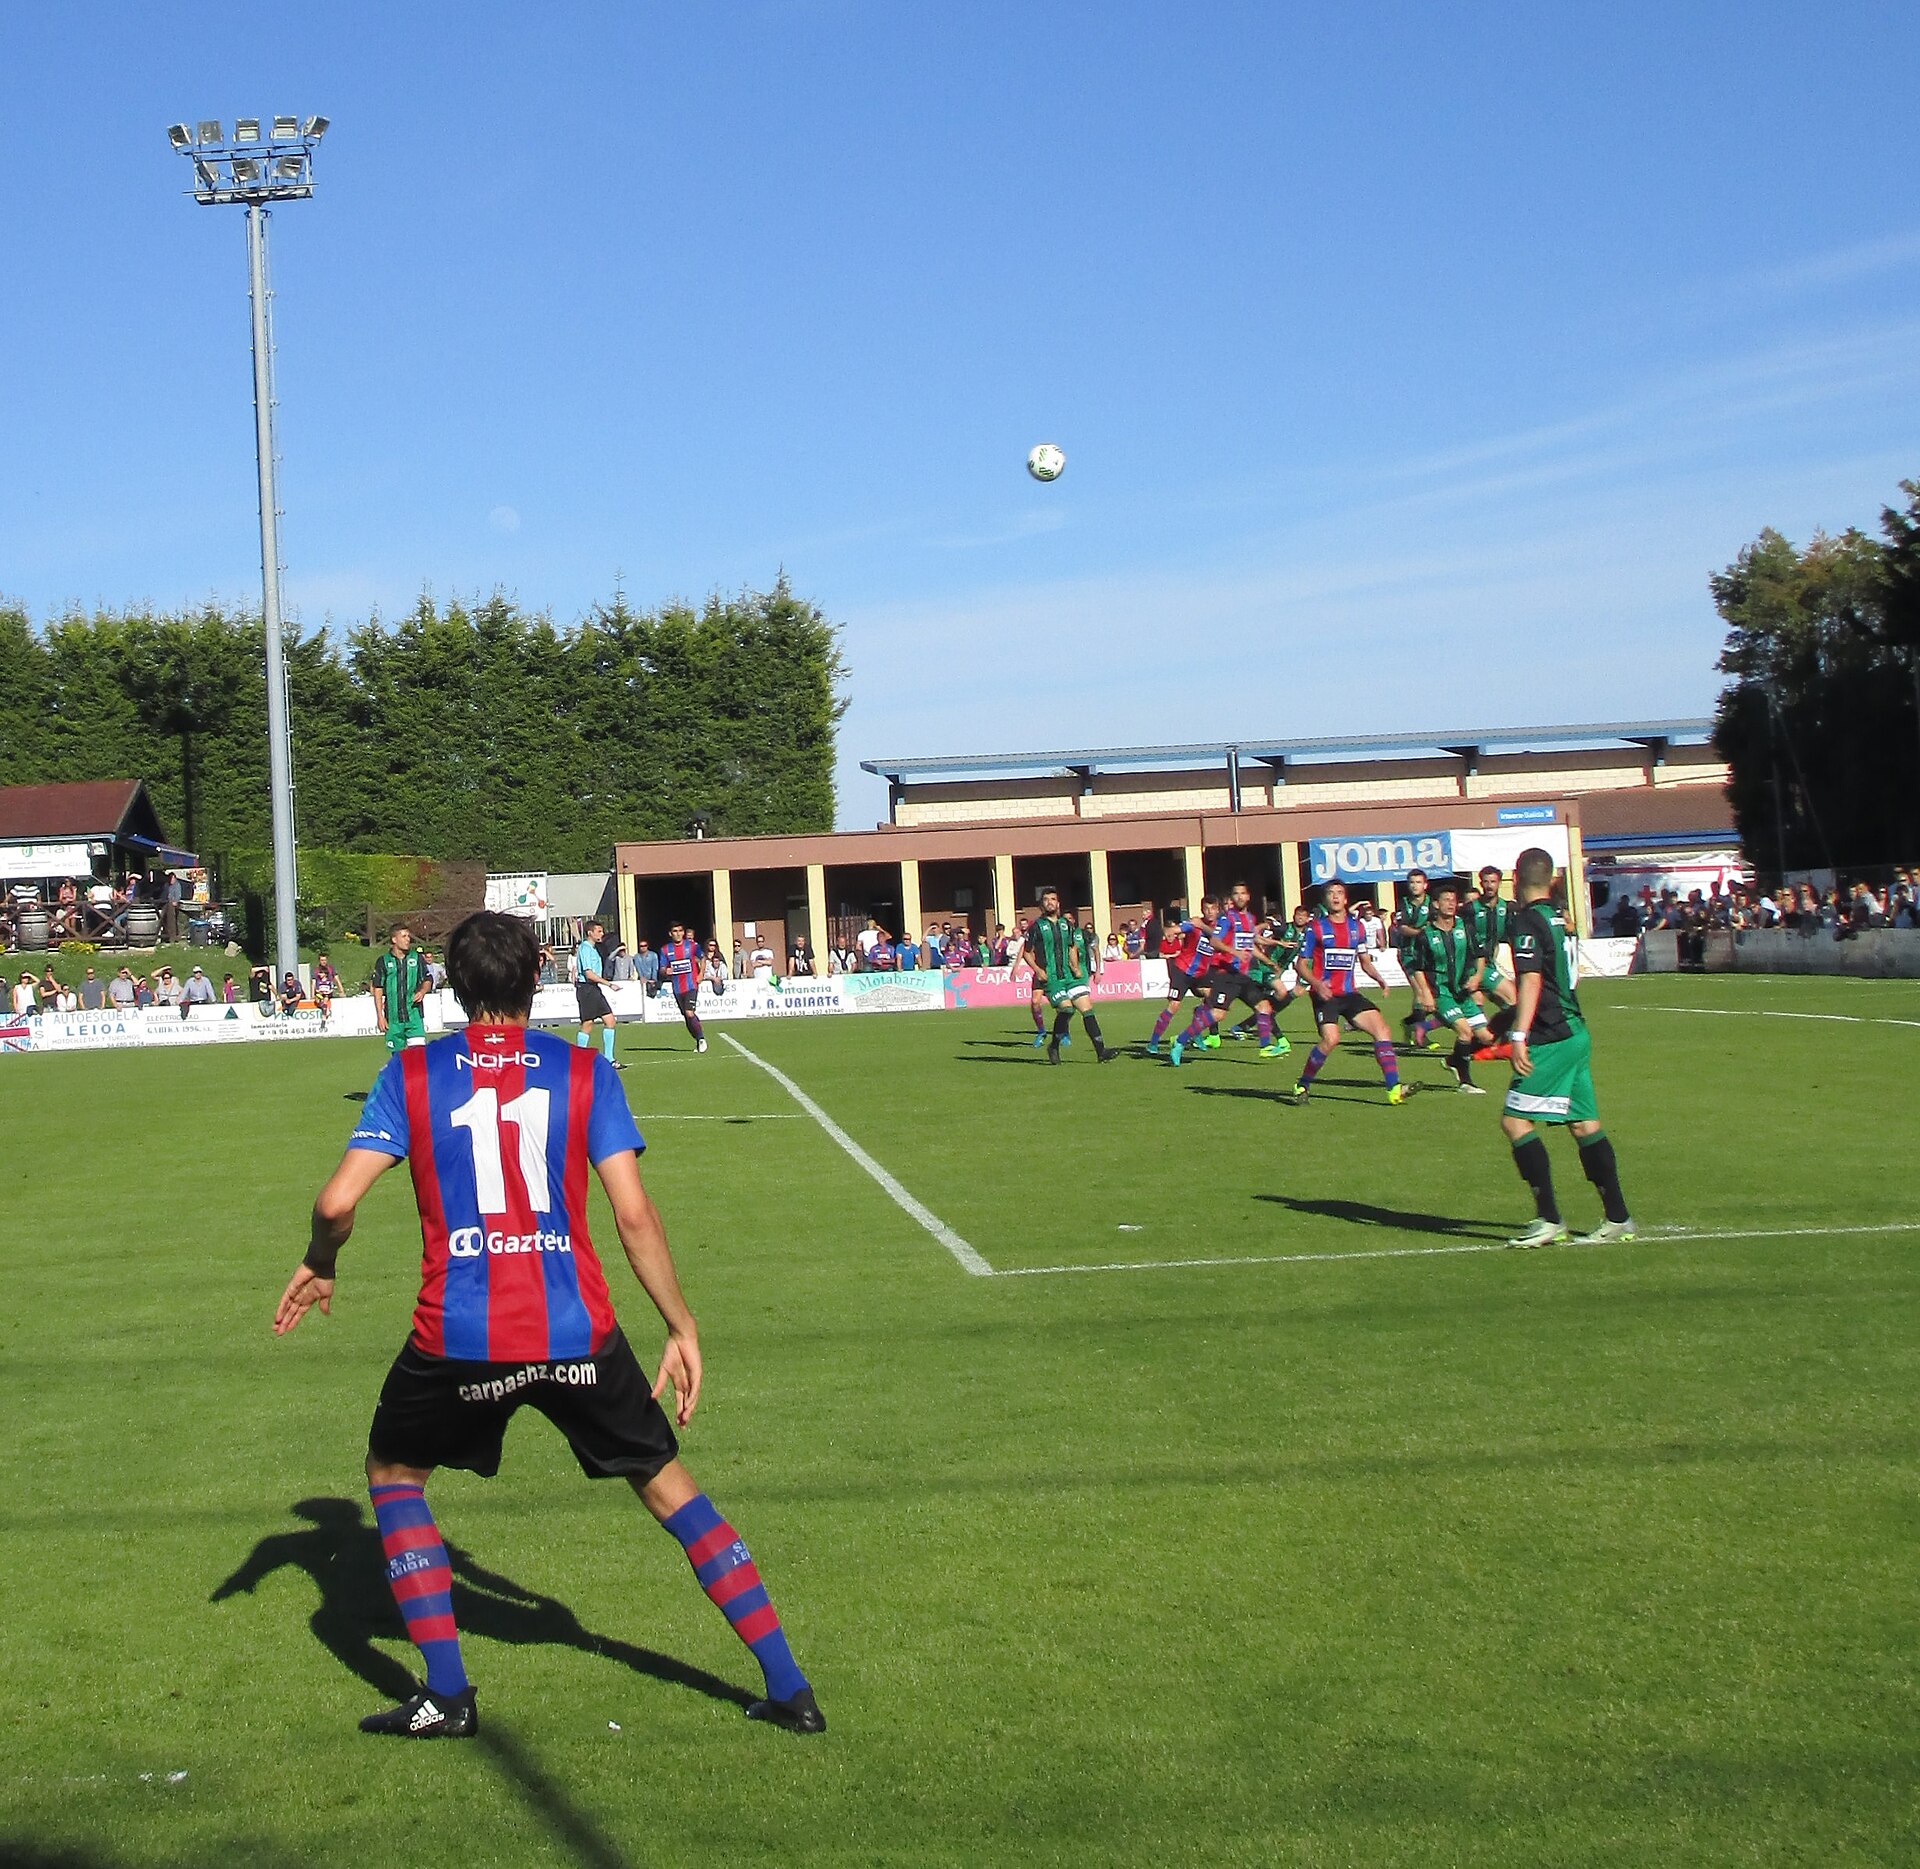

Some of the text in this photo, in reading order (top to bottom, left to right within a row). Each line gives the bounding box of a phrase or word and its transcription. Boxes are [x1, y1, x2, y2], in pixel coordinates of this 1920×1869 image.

[857, 973, 927, 991] Motabarri
[1097, 982, 1142, 995] KUTXA
[1169, 988, 1179, 999] 10
[1217, 993, 1226, 1004] 5
[704, 999, 738, 1007] MOTOR
[53, 1010, 140, 1025] AUTOESCUELA
[66, 1023, 126, 1037] LEIOA
[450, 1086, 551, 1215] 11
[410, 1712, 446, 1731] adidas
